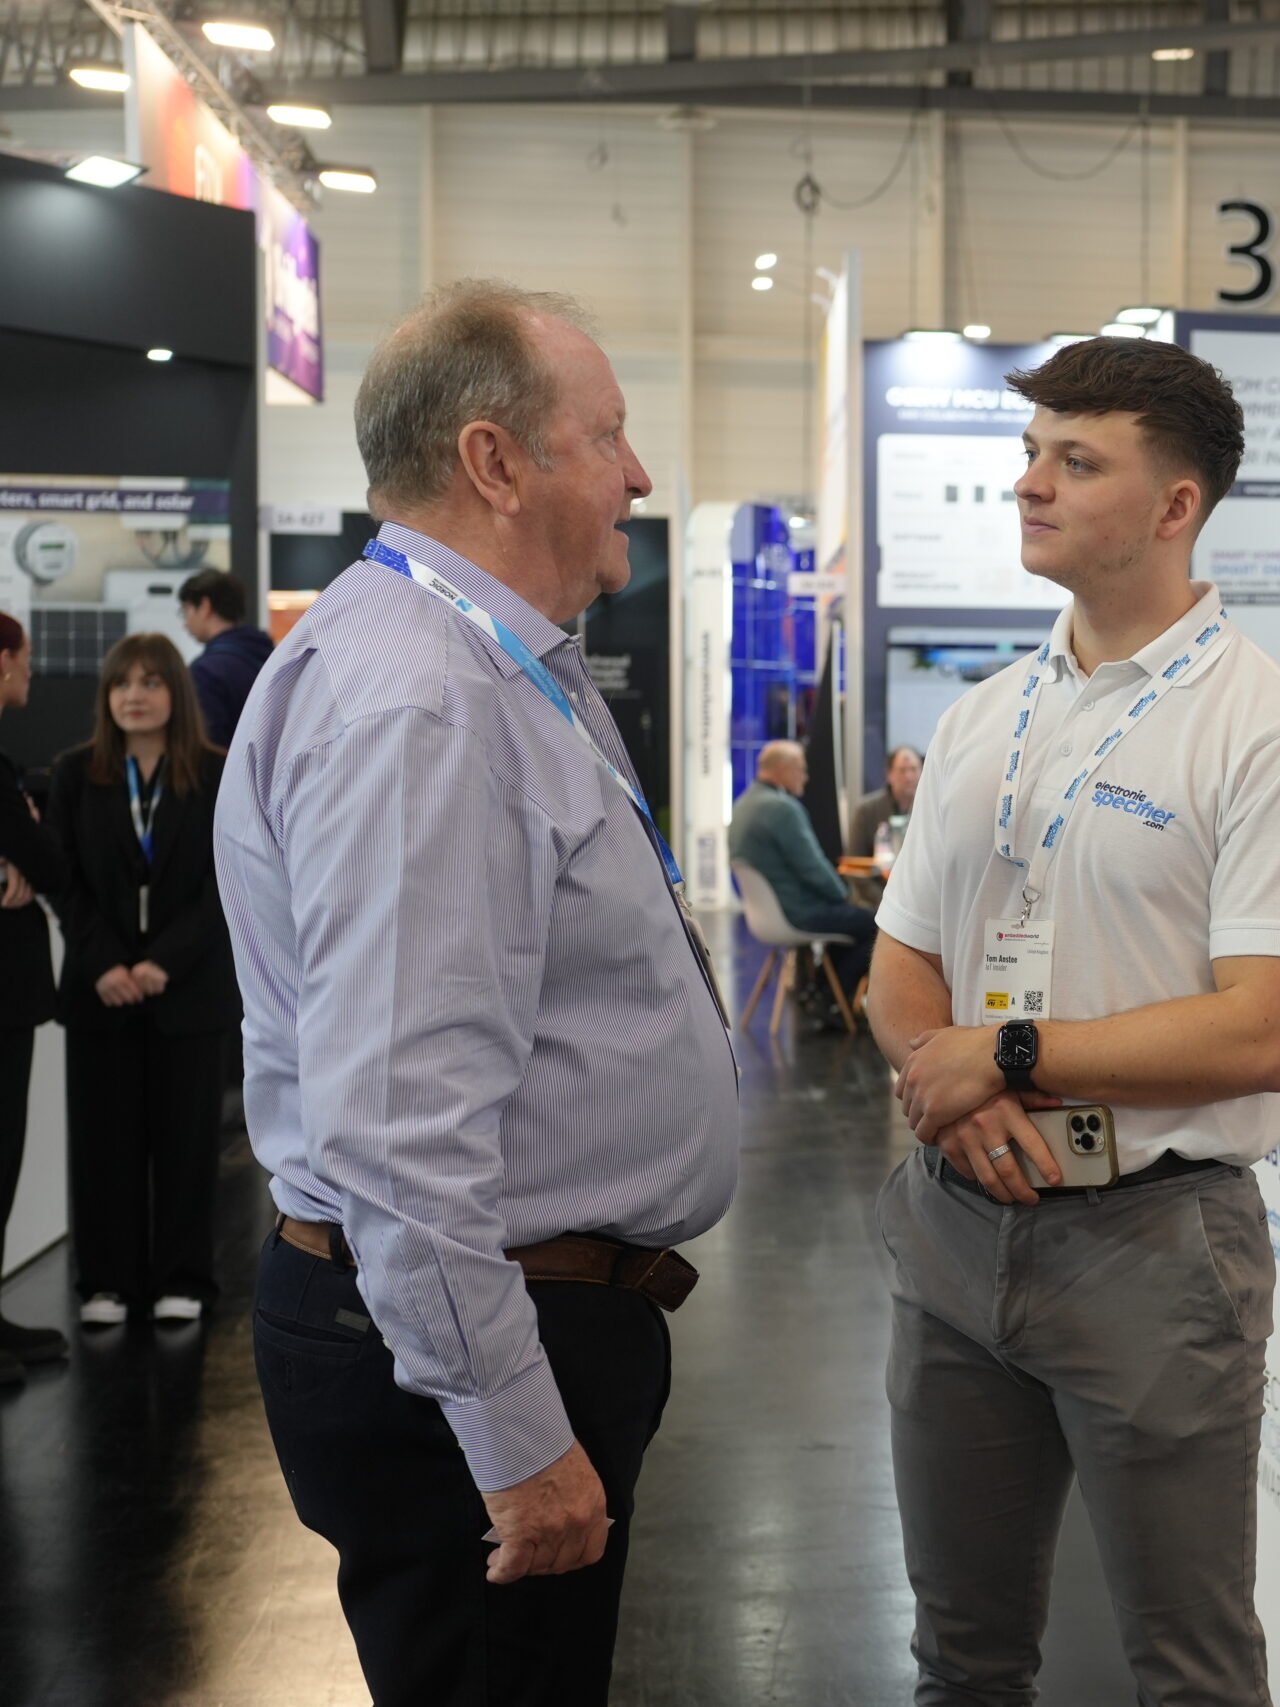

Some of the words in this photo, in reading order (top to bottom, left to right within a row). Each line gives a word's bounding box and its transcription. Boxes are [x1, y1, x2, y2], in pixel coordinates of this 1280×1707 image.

[39, 492, 83, 508] smart
[123, 492, 153, 510] and
[1095, 781, 1147, 802] electronic
[1091, 790, 1176, 825] specifier
[1142, 820, 1165, 831] .com
[986, 954, 998, 963] Tom
